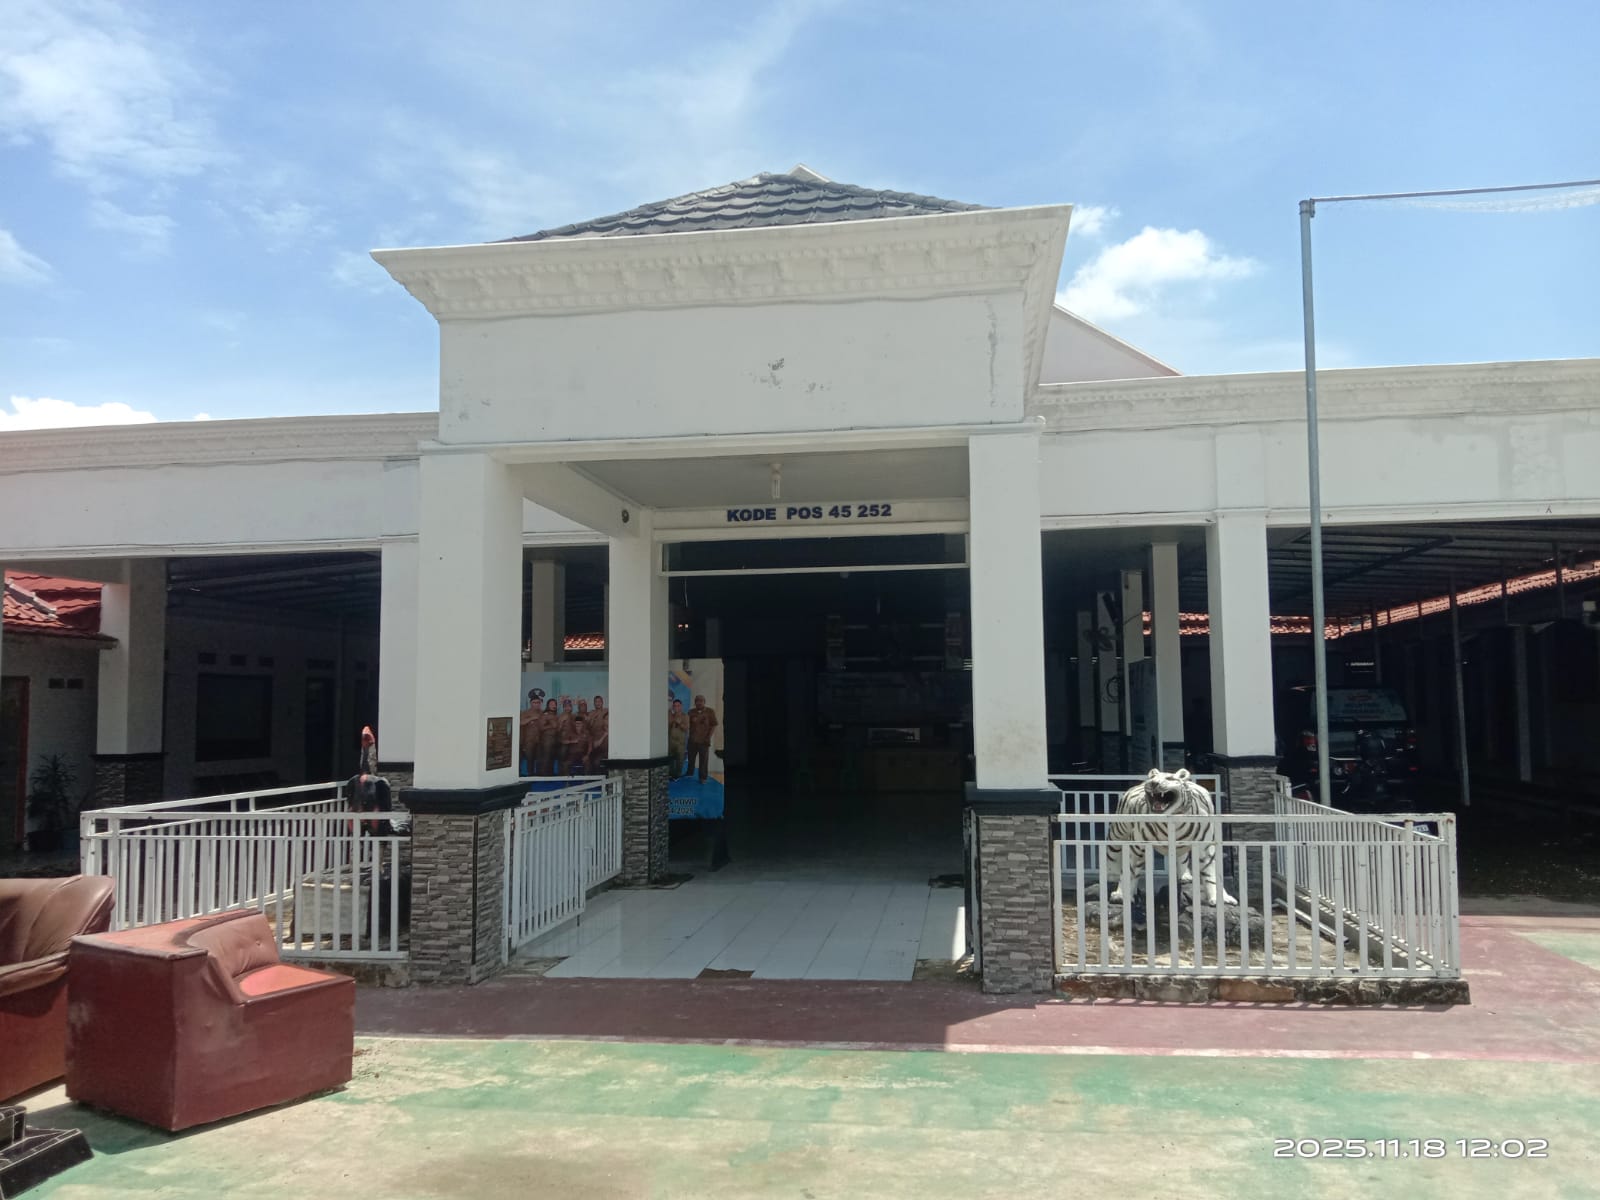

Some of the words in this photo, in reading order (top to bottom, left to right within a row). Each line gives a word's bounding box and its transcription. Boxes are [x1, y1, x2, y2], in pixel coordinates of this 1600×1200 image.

[727, 508, 776, 522] KODE
[786, 506, 823, 520] POS
[828, 505, 852, 518] 45
[857, 504, 892, 518] 252
